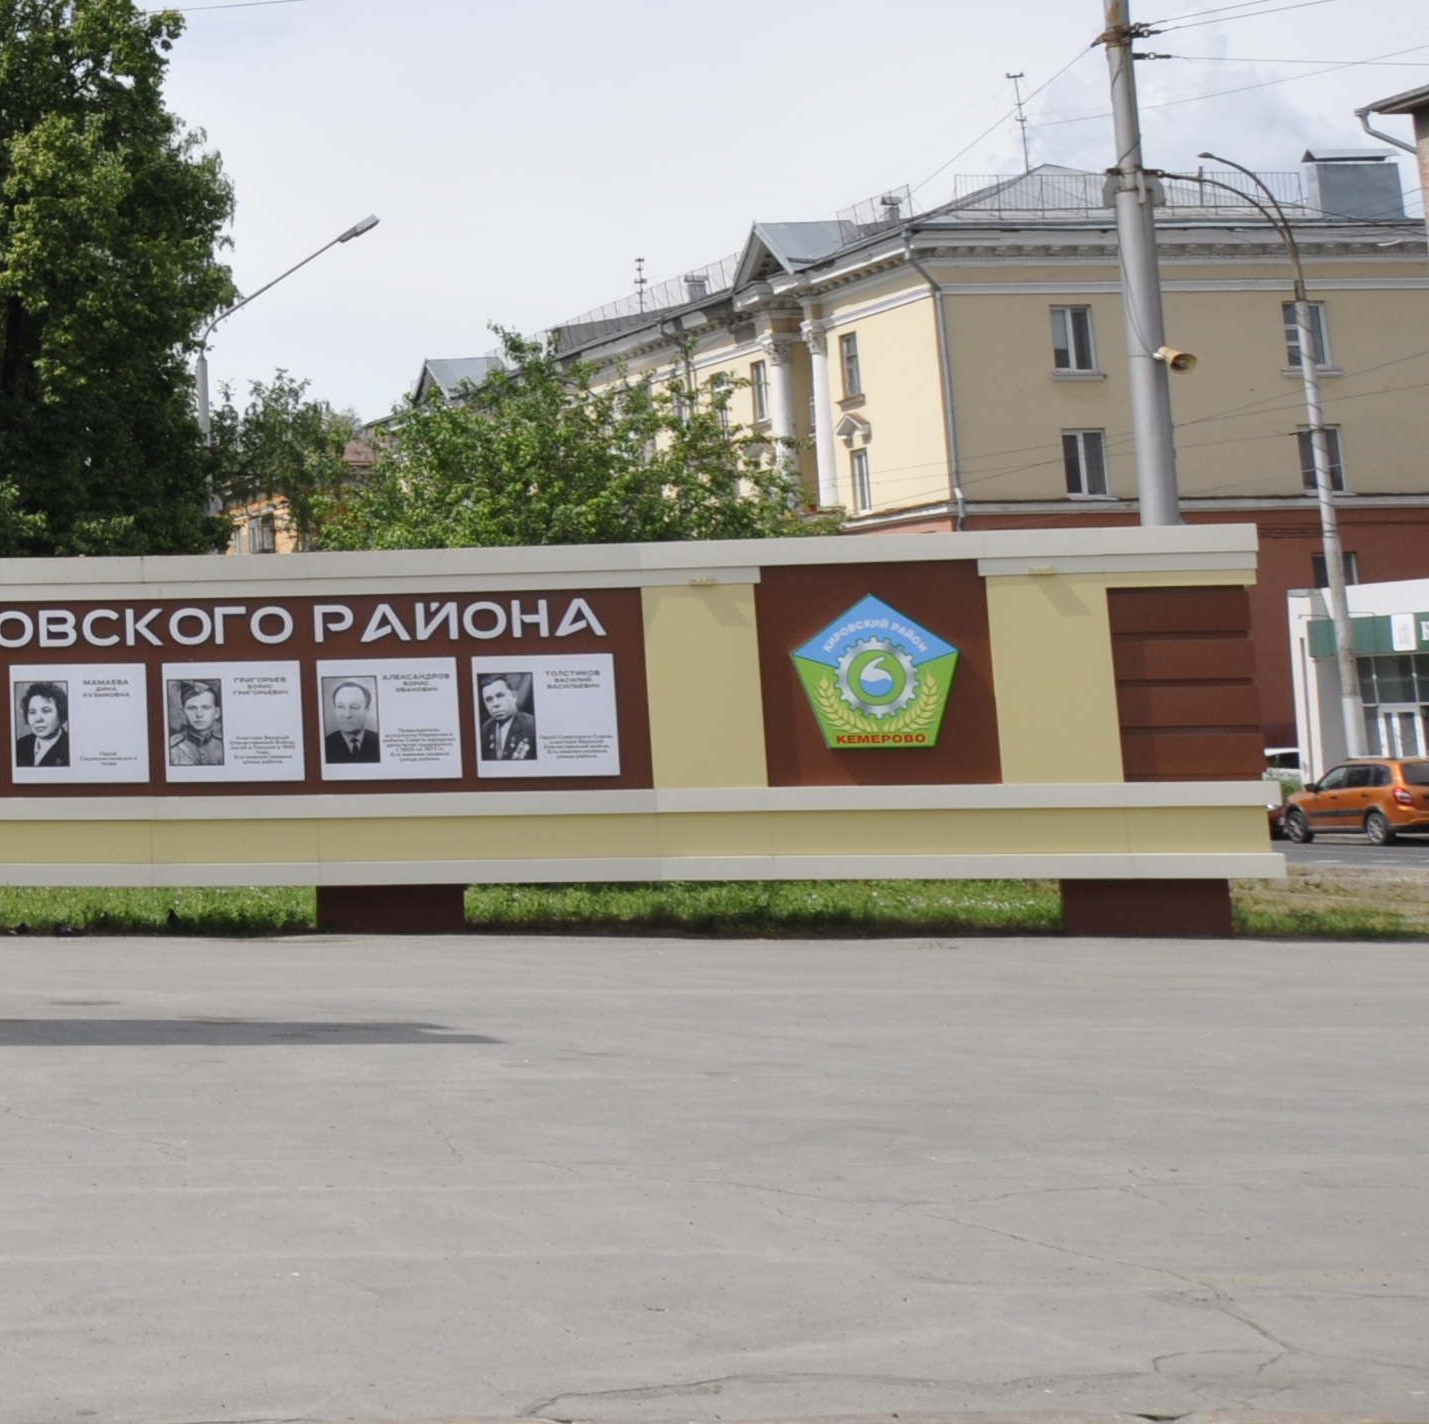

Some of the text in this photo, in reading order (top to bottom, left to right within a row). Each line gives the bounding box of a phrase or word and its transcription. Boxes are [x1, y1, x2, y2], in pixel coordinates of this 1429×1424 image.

[313, 598, 607, 643] РАЙОНА
[823, 618, 927, 653] КИРОВСКИЙ РАЙОН
[836, 734, 926, 744] КЕМЕРОВО
